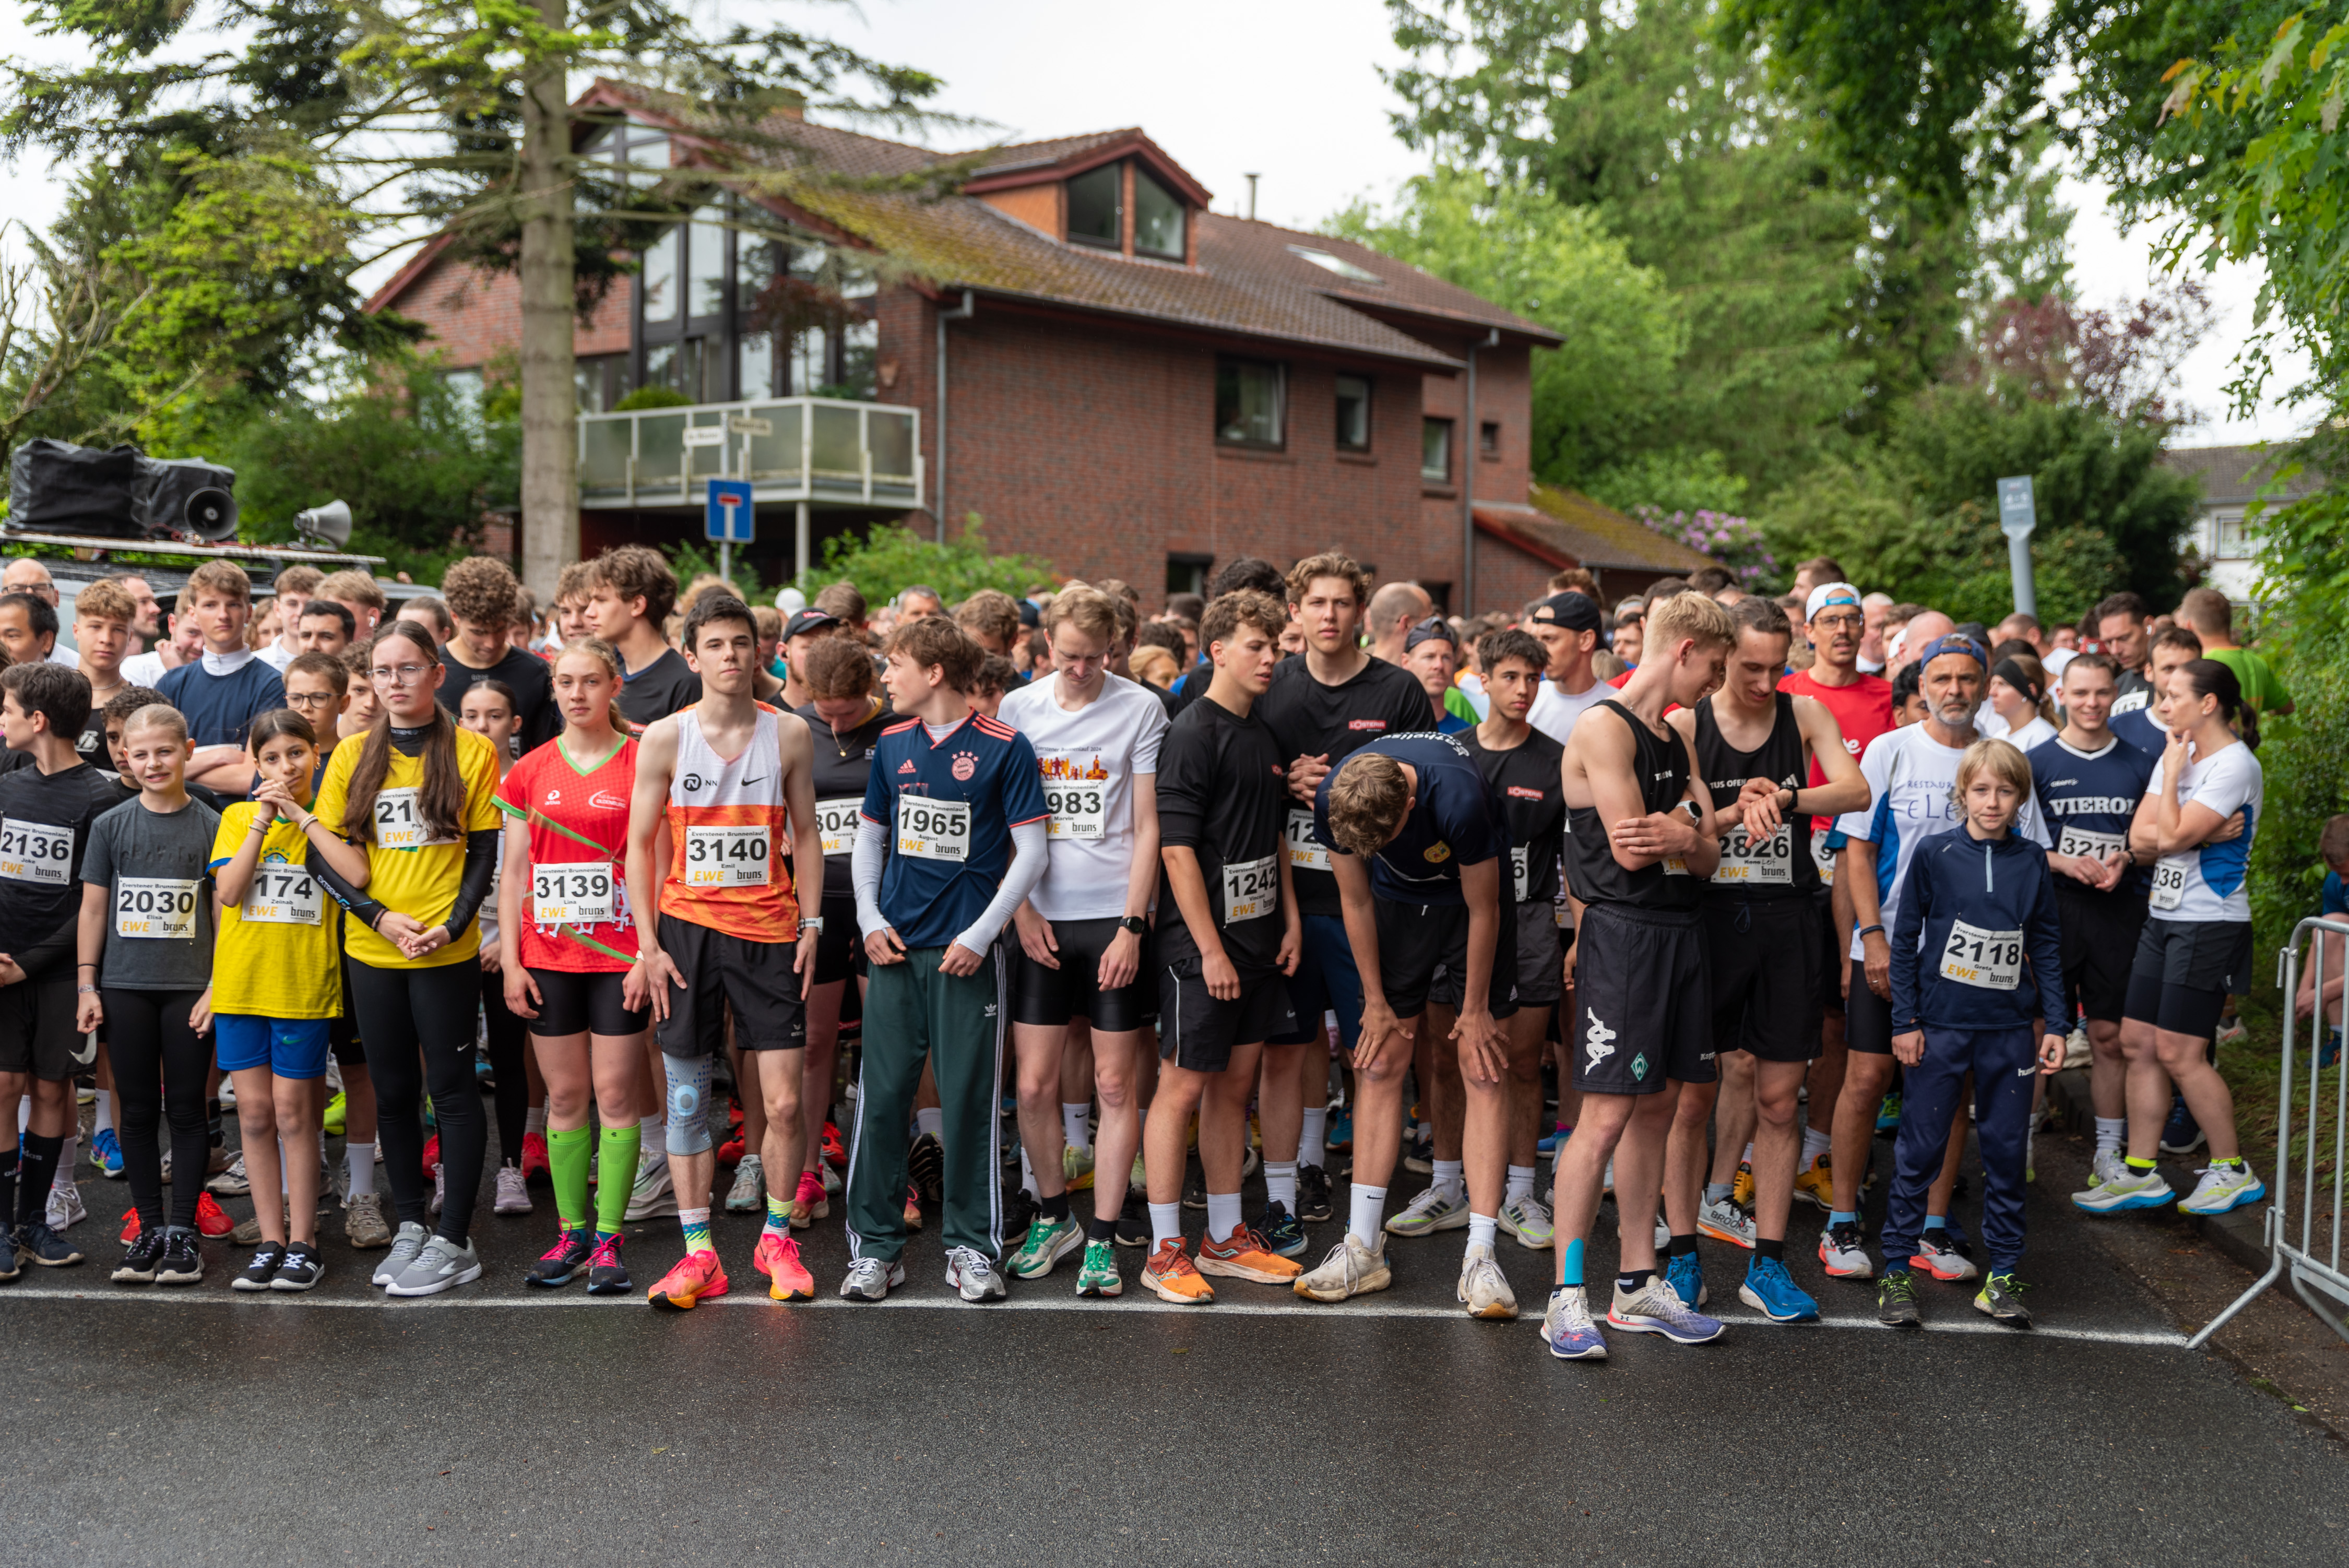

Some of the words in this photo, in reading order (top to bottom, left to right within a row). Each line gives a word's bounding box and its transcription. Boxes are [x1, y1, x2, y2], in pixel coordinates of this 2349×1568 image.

[1710, 780, 1725, 789] TUS
[376, 800, 411, 823] 21
[904, 800, 930, 809] Everstener
[931, 804, 965, 812] Brunnenlauf
[1047, 792, 1101, 814] 983
[2048, 796, 2136, 816] VIEROL
[901, 807, 966, 837] 1965
[1072, 822, 1097, 832] bruns
[385, 831, 414, 843] EWE
[1289, 820, 1318, 845] 12
[1, 831, 69, 861] 2136
[689, 838, 767, 862] 3140
[822, 839, 840, 850] WE
[899, 838, 925, 852] EWE
[935, 842, 960, 854] bruns
[1718, 835, 1789, 859] 2826
[1289, 849, 1314, 863] EWE
[1, 861, 25, 875] EWE
[35, 865, 62, 878] bruns
[694, 870, 725, 882] EWE
[737, 869, 762, 880] bruns
[1719, 866, 1749, 878] EWE
[1762, 865, 1786, 877] bruns
[255, 874, 313, 899] 174
[317, 874, 342, 901] EXTREME
[536, 875, 609, 898] 3139
[1228, 865, 1276, 898] 1242
[119, 890, 194, 914] 2030
[1249, 893, 1265, 901] Vincent
[248, 905, 278, 917] EWE
[290, 906, 316, 918] bruns
[541, 907, 567, 918] EWE
[579, 905, 604, 916] bruns
[1232, 902, 1256, 917] EWE
[122, 921, 150, 932] EWE
[163, 921, 188, 932] bruns
[1947, 933, 2020, 966] 2118
[1947, 964, 1979, 981] EWE
[1989, 972, 2014, 984] bruns
[1700, 1051, 1716, 1061] Kapp
[1710, 1210, 1753, 1233] BROOKS
